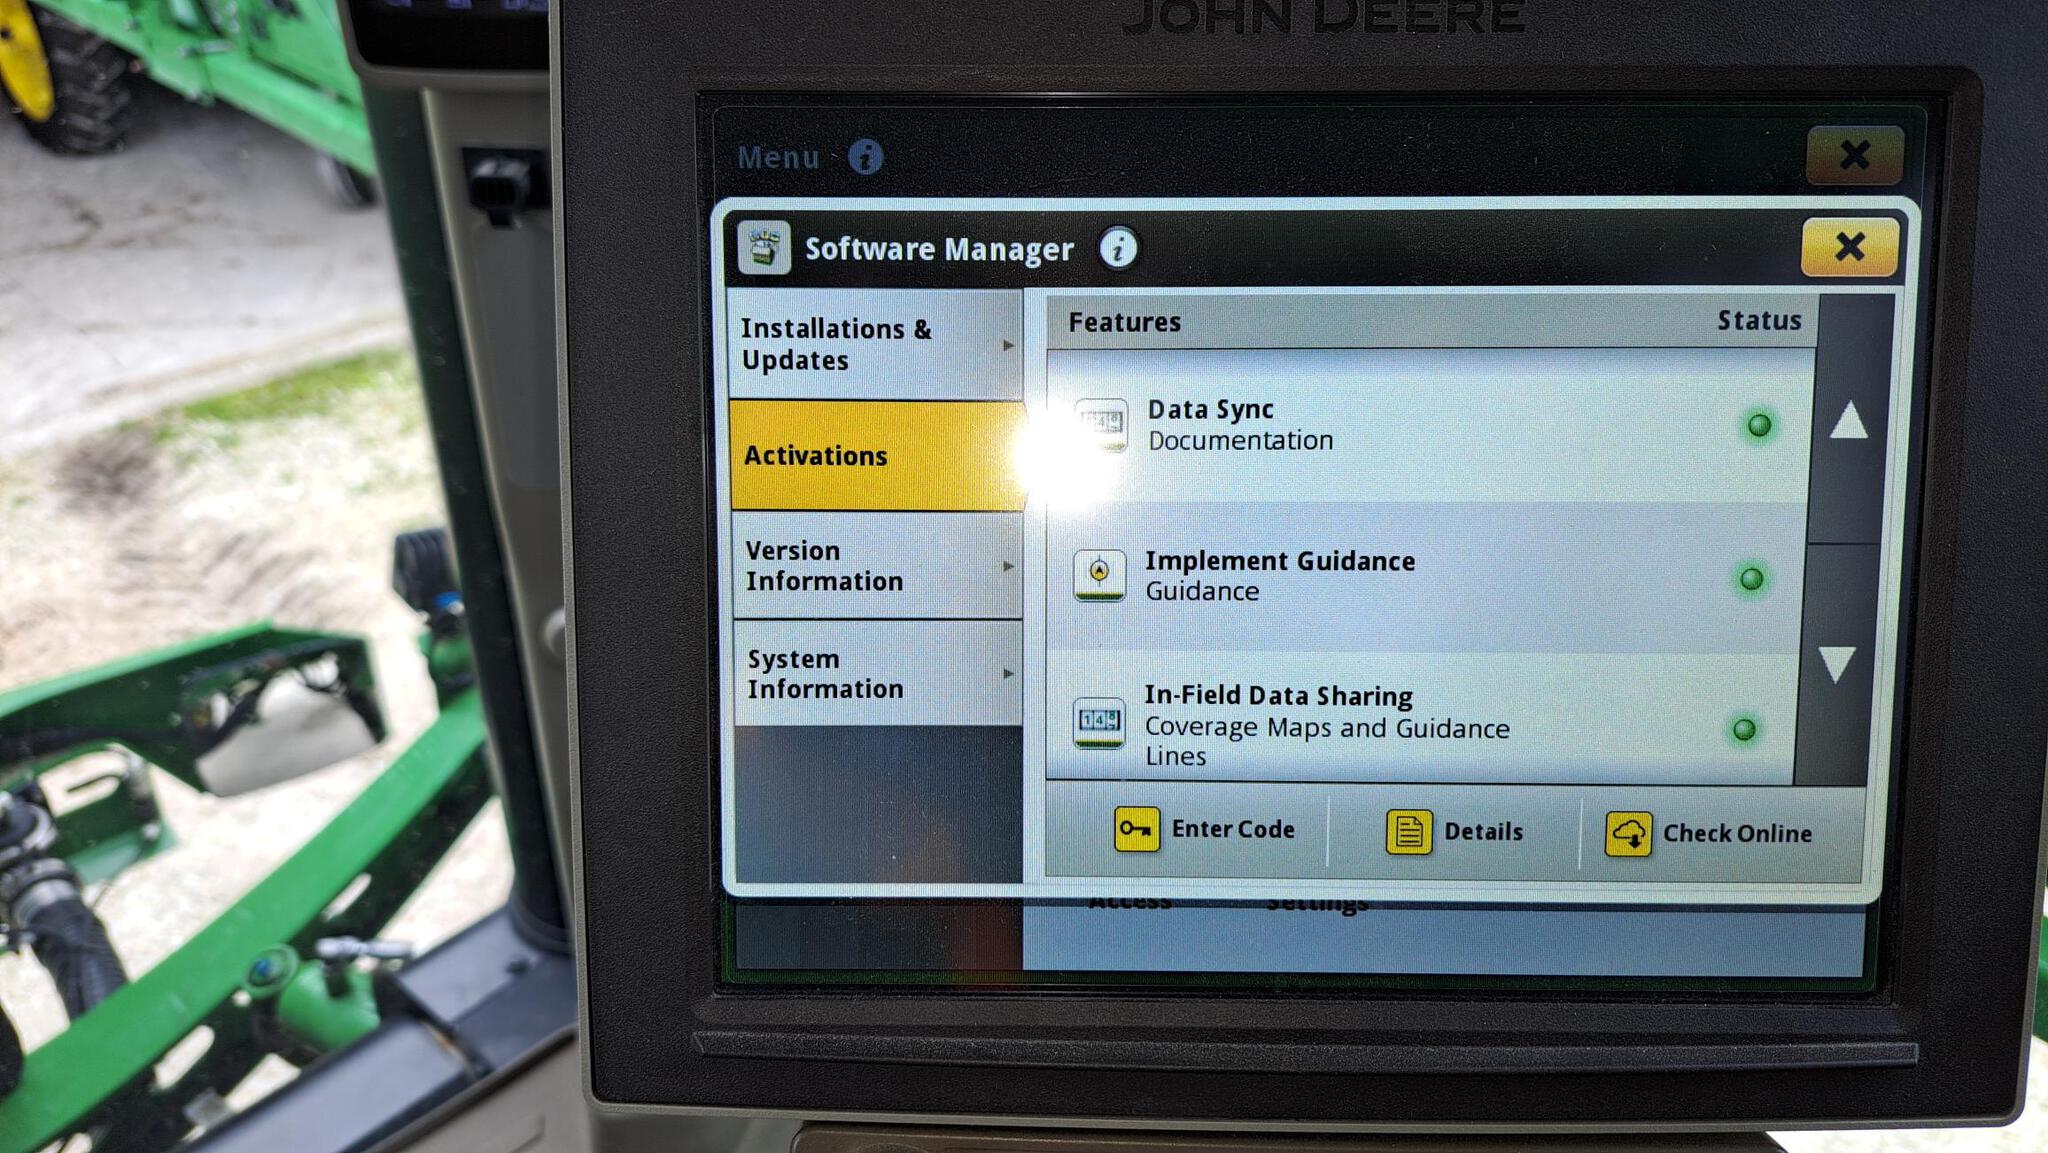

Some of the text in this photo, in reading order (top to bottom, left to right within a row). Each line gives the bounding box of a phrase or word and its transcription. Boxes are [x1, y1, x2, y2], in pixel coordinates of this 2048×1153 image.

[1122, 0, 1526, 35] JOHN DEERE
[738, 145, 819, 170] Menu
[806, 236, 1075, 269] Software Manager
[741, 317, 932, 340] Installations &
[1069, 311, 1182, 333] Features
[1718, 309, 1802, 331] Status
[743, 349, 849, 376] Updates
[1149, 399, 1274, 424] Data Sync
[1149, 429, 1334, 451] Documentation
[744, 444, 888, 467] Activations
[746, 539, 841, 561] Version
[1146, 550, 1416, 576] Implement Guidance
[746, 570, 904, 592] Information
[1146, 579, 1260, 602] Guidance
[748, 649, 840, 674] System
[748, 678, 904, 700] Information
[1145, 683, 1413, 712] In-Field Data Sharing
[1145, 716, 1511, 743] Coverage Maps and Guidance
[1146, 746, 1207, 767] Lines
[1172, 819, 1295, 839] Enter Code
[1445, 821, 1524, 842] Details
[1664, 823, 1813, 844] Check Online
